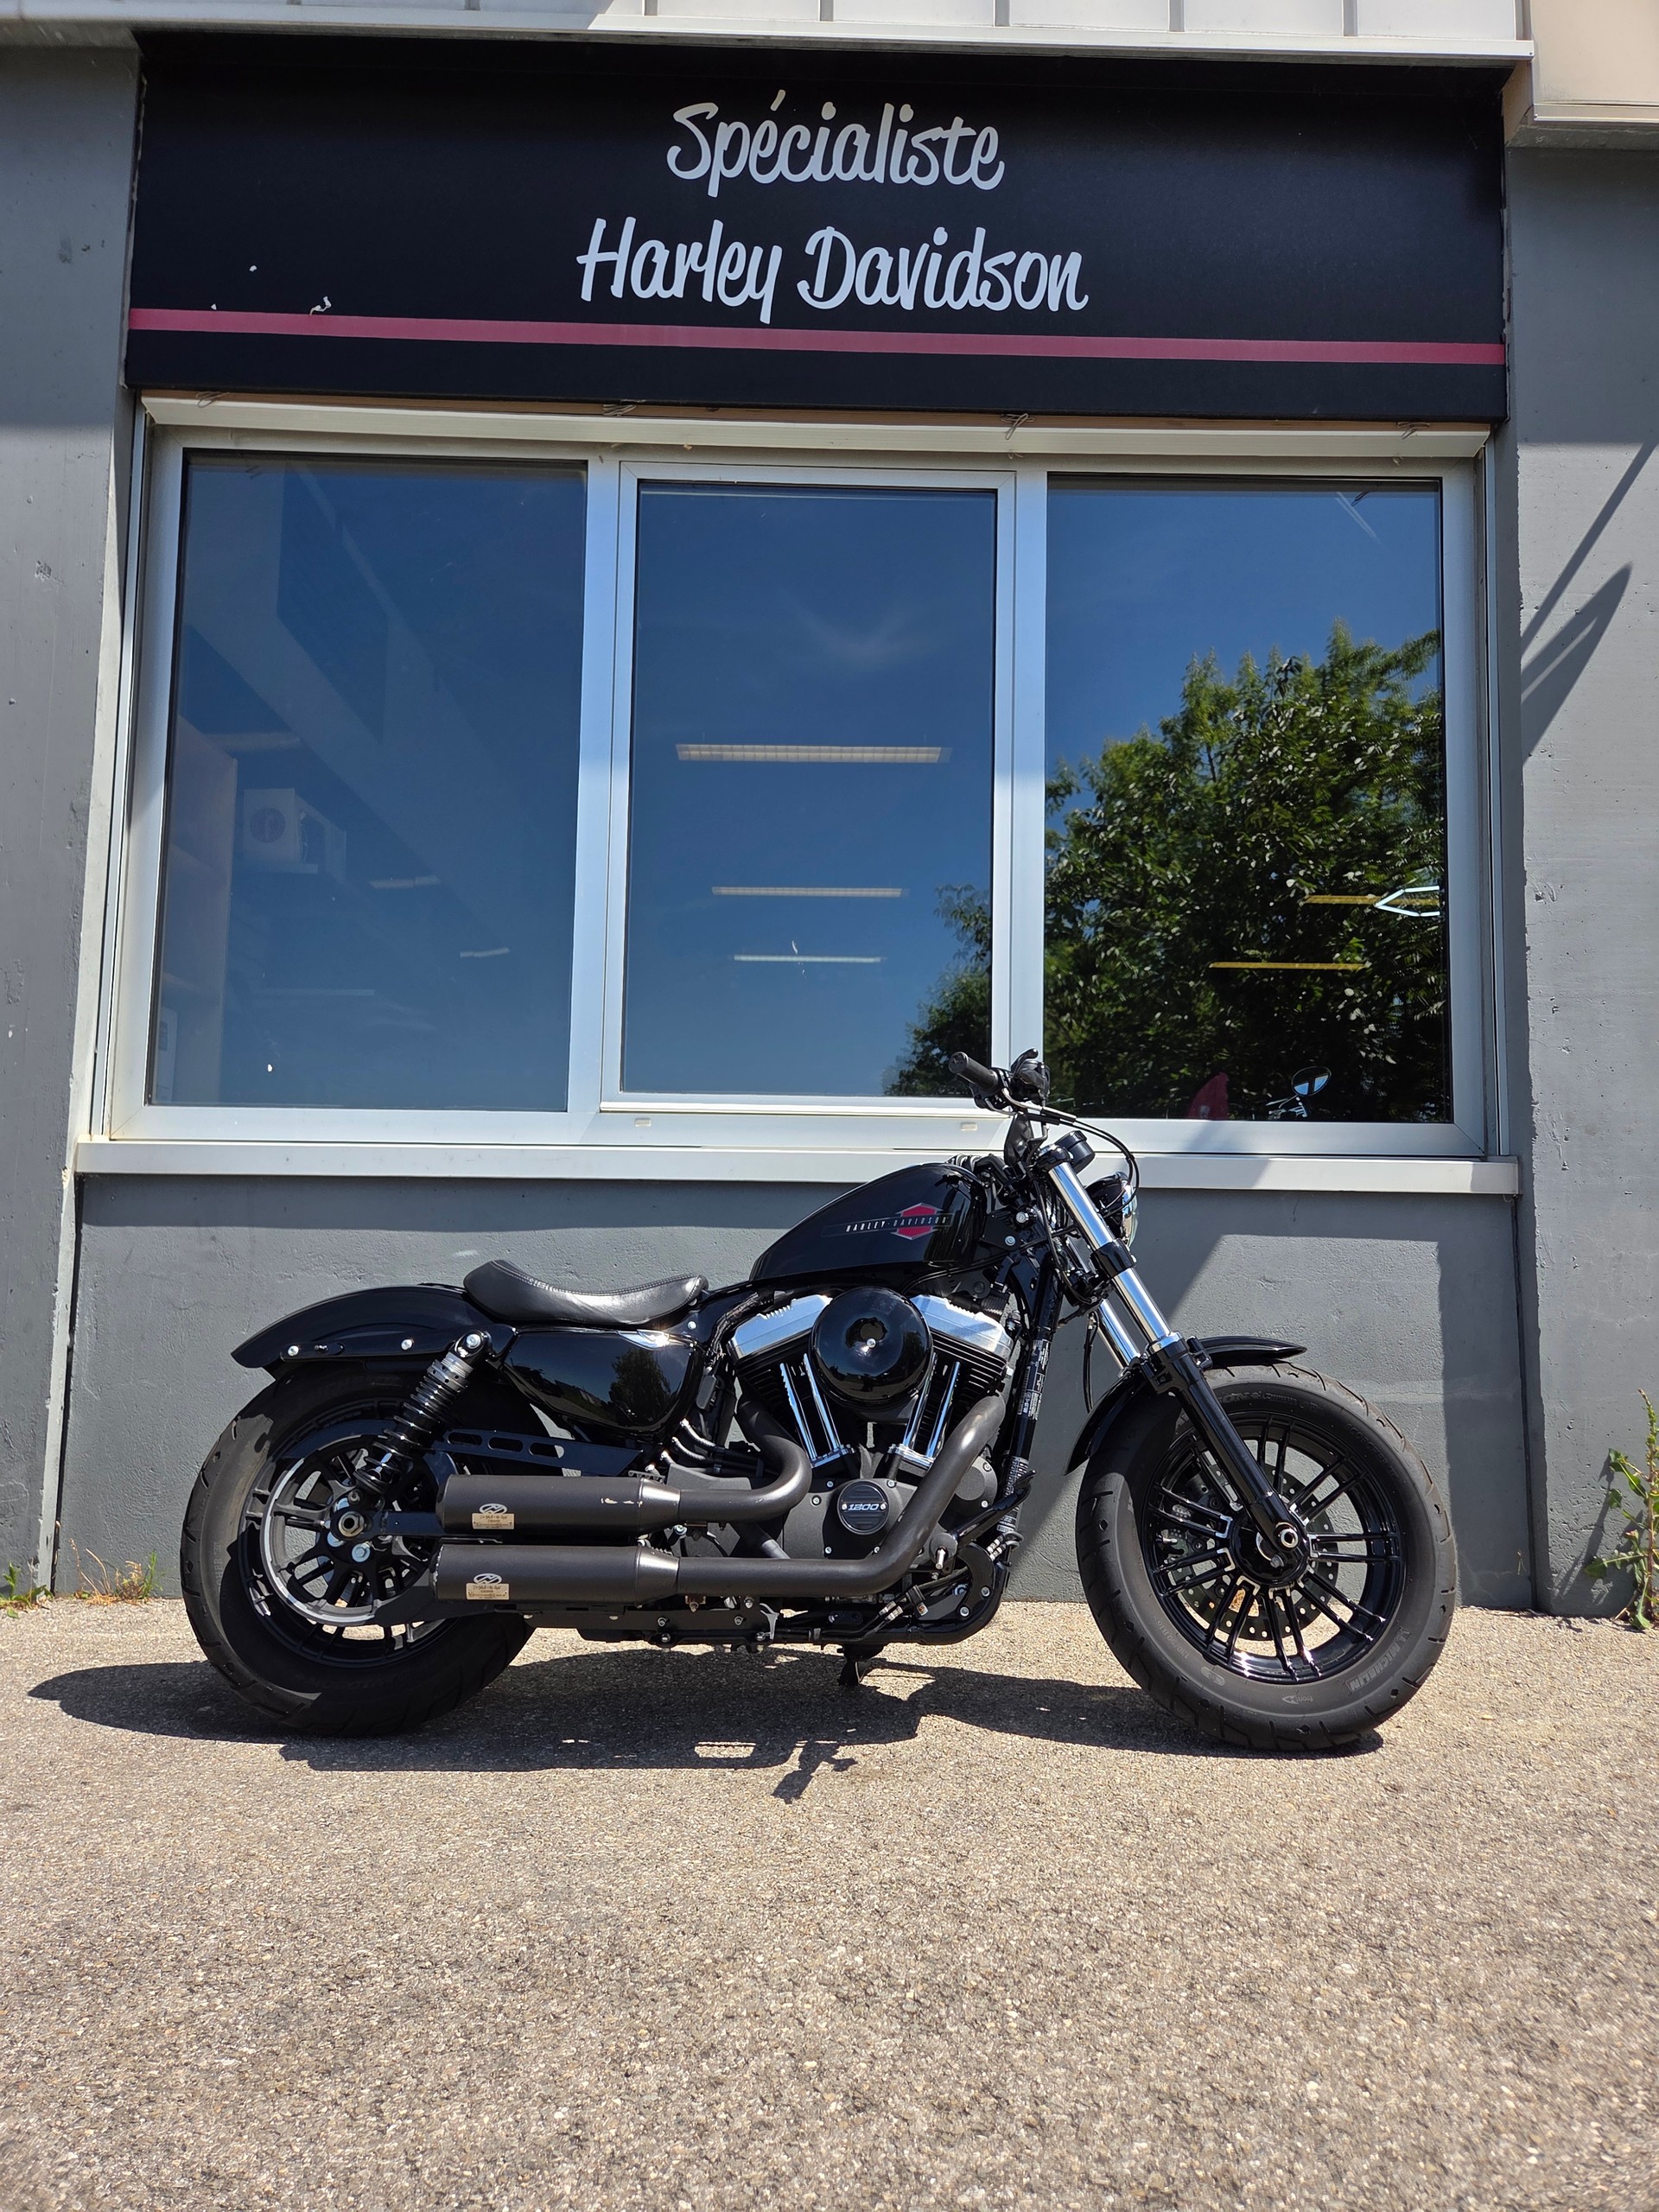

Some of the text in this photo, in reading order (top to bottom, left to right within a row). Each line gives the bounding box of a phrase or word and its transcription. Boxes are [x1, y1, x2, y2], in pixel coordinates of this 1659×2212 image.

[666, 89, 1005, 198] Spécialiste
[575, 216, 1090, 325] Harley Davidson
[1349, 1642, 1402, 1691] MICHELIN
